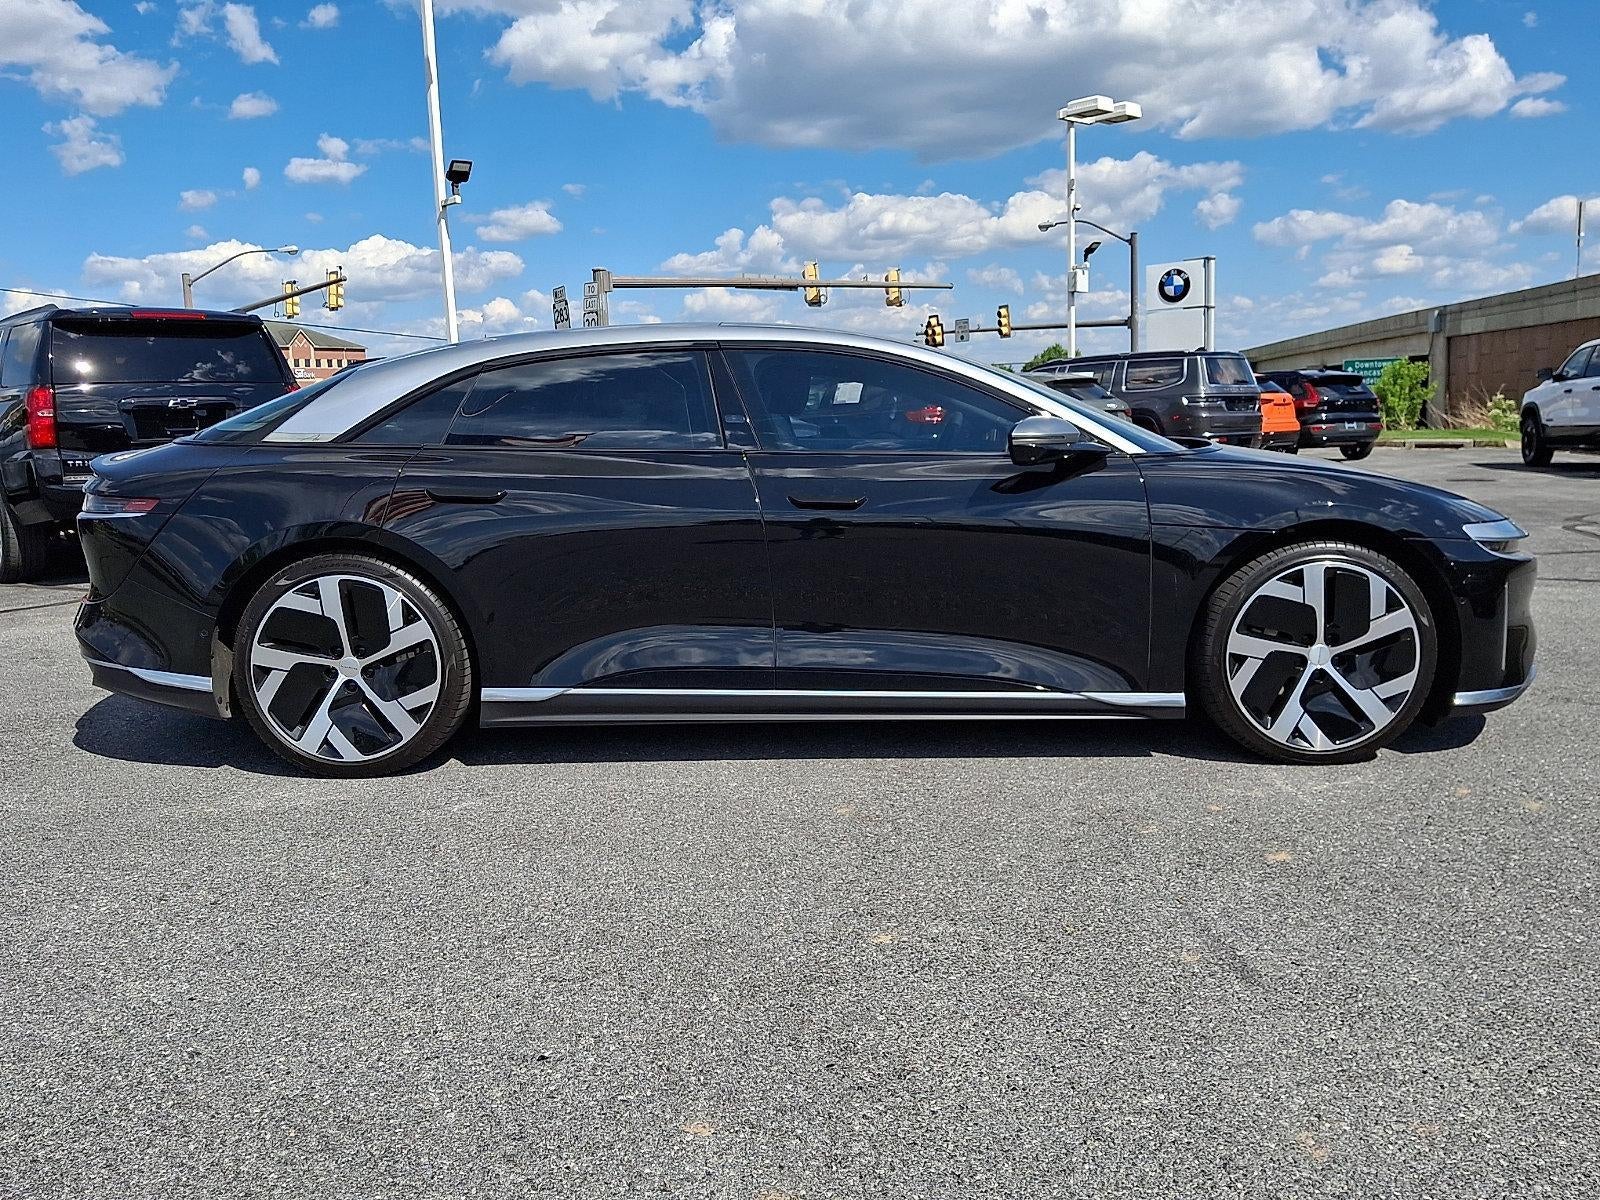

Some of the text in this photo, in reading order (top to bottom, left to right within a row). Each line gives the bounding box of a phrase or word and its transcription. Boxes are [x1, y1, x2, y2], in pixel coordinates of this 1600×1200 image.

[587, 285, 596, 294] TO
[585, 299, 597, 310] EAST
[554, 306, 569, 325] 283
